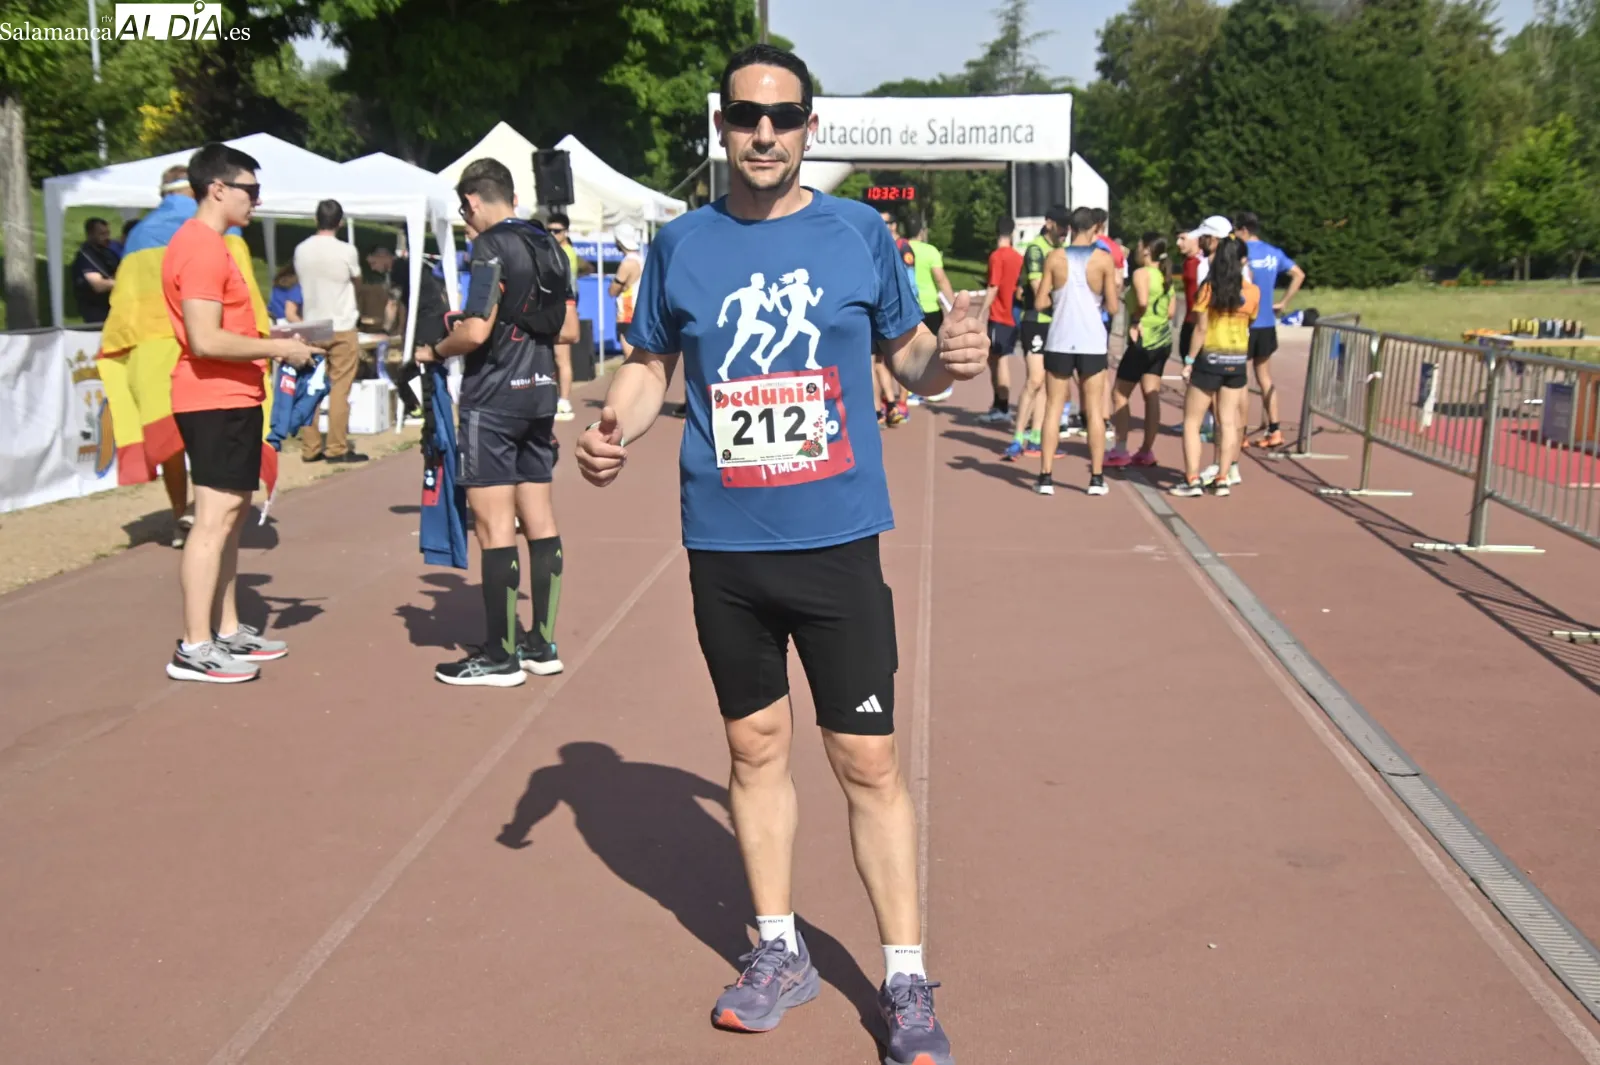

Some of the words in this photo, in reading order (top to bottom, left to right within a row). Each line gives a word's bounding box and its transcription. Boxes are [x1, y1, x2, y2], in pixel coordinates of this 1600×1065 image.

[816, 117, 892, 145] utación
[899, 125, 917, 145] de
[926, 118, 1034, 145] Salamanca
[730, 405, 807, 446] 212
